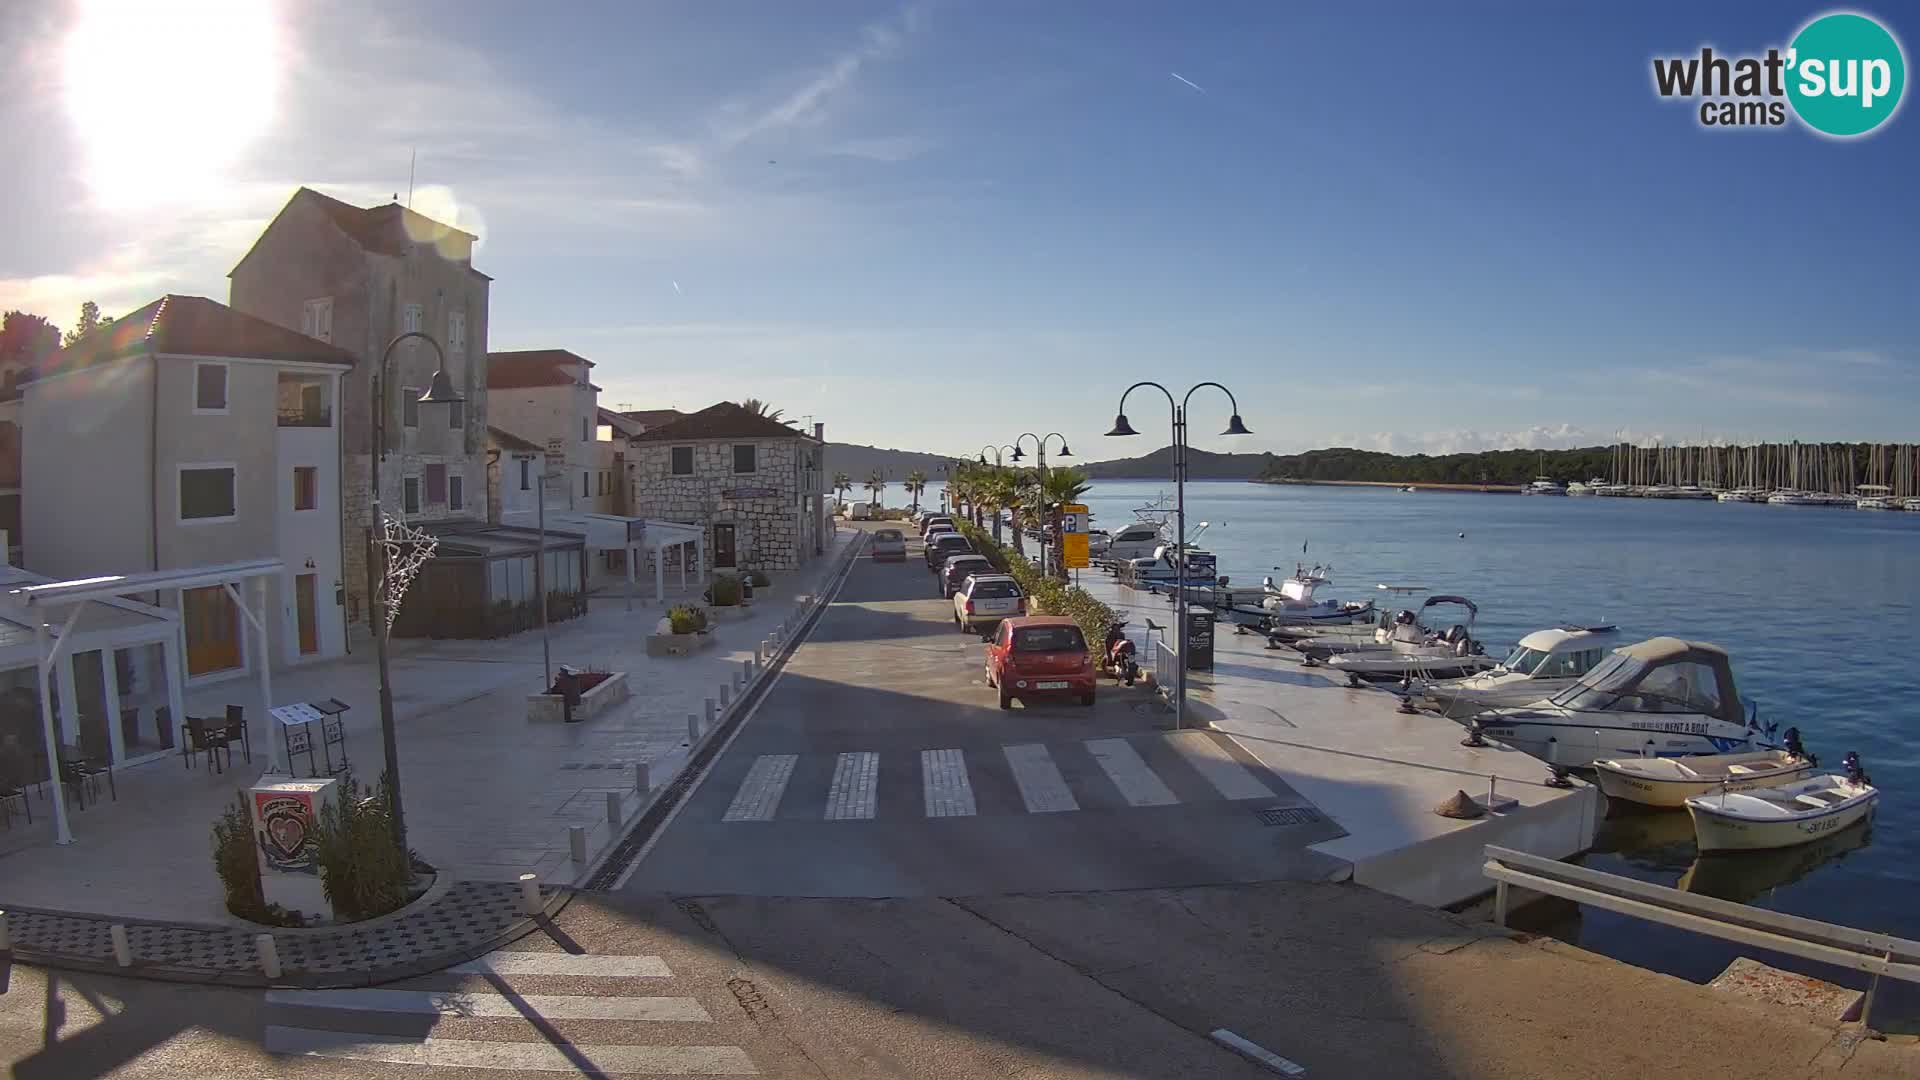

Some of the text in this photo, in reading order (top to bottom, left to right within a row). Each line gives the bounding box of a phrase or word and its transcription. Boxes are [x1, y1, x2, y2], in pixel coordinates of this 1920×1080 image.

[1065, 515, 1076, 531] P
[1664, 722, 1684, 734] RENT
[1684, 722, 1690, 733] A
[1691, 723, 1709, 735] BOAT
